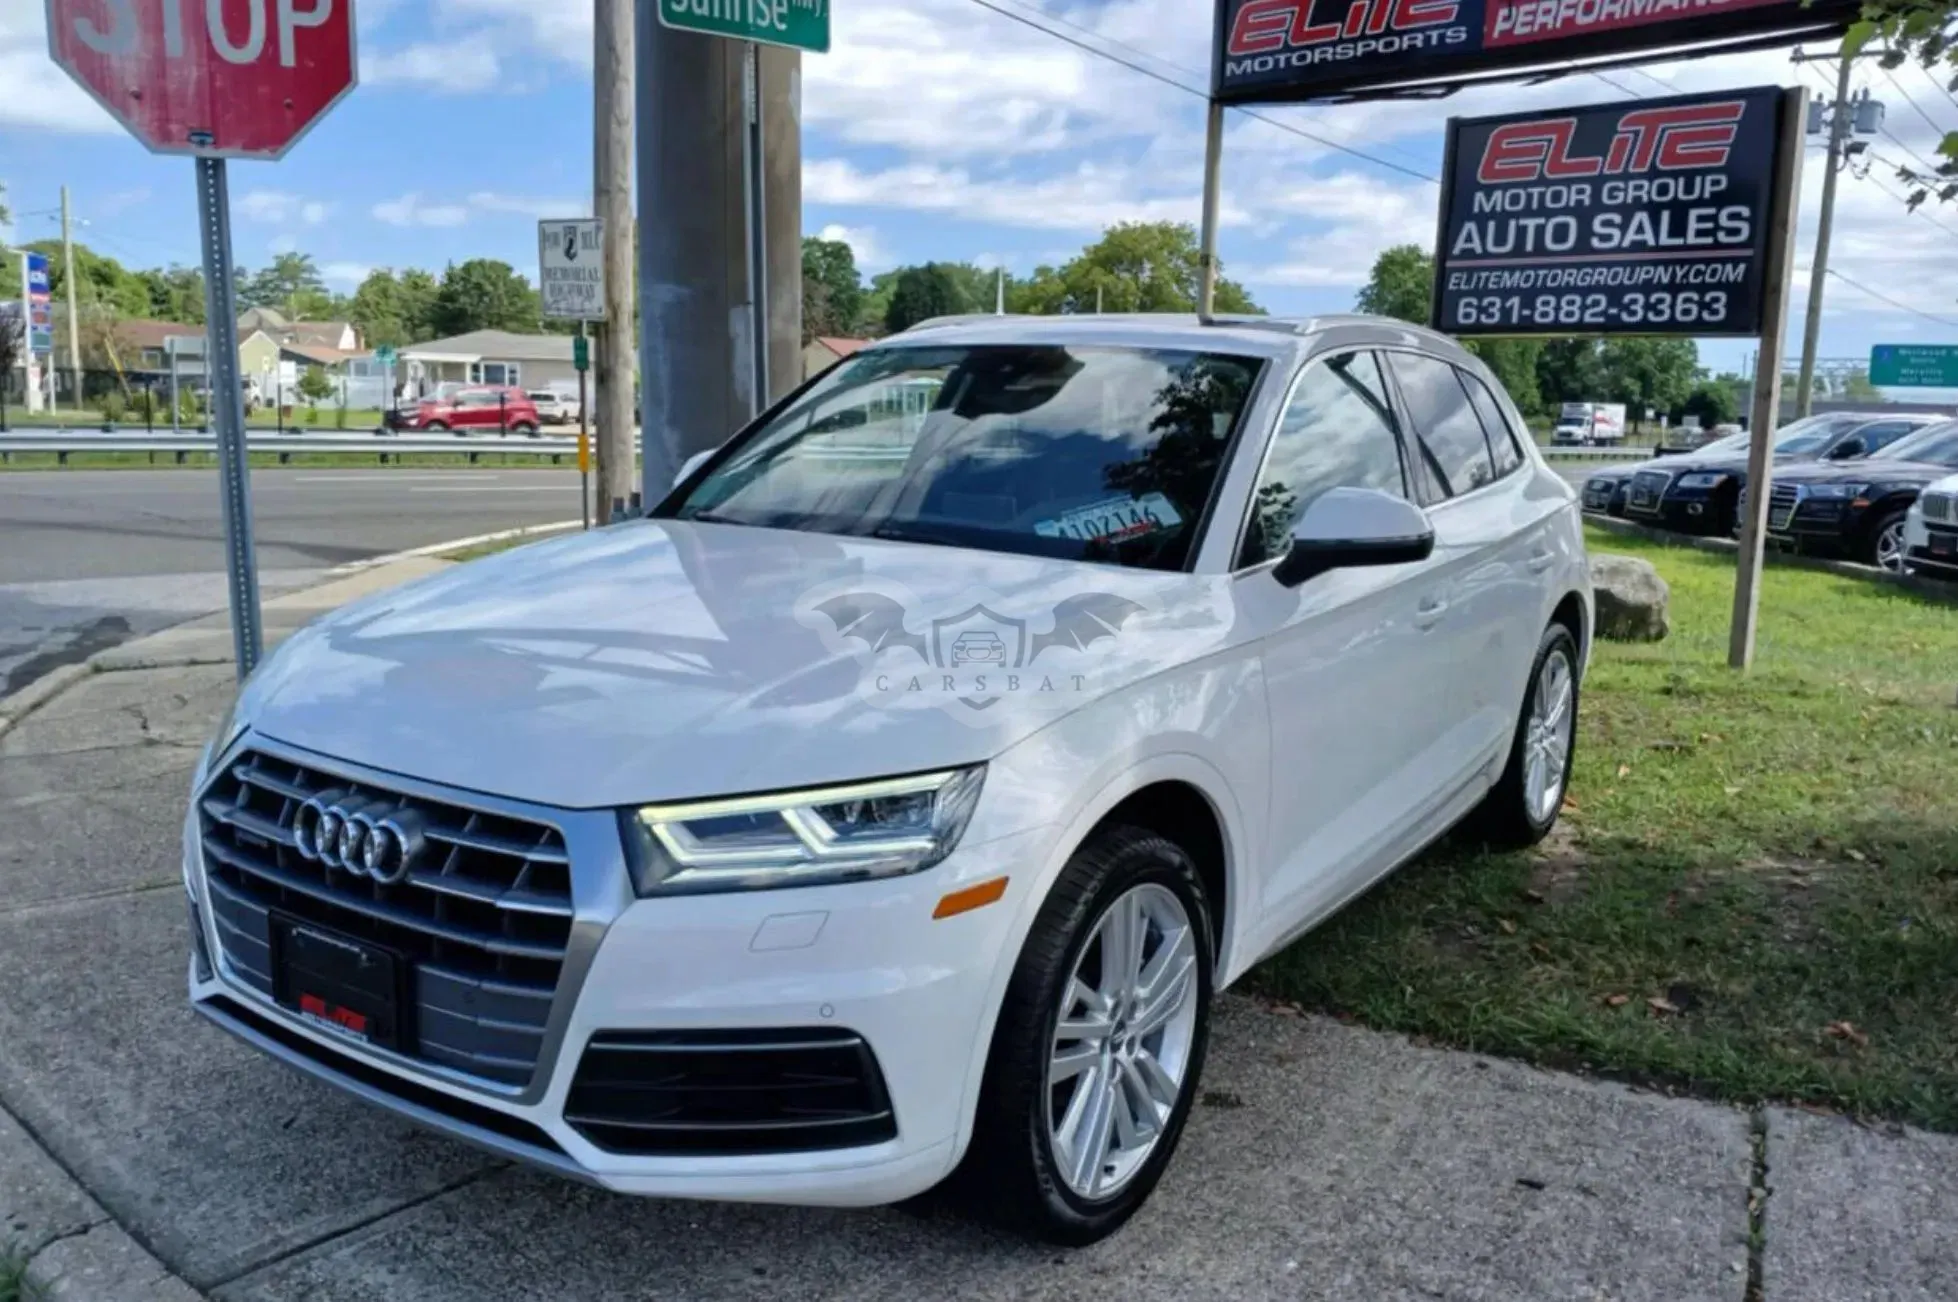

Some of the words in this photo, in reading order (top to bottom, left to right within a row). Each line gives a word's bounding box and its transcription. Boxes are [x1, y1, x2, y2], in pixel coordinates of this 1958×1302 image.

[74, 0, 333, 67] STOP
[1225, 26, 1468, 77] MOTORSPORTS
[1472, 183, 1592, 213] MOTOR
[1601, 174, 1728, 205] GROUP
[1452, 215, 1577, 255] AUTO
[1590, 205, 1750, 249] SALES
[1448, 263, 1747, 290] ELITEMOTORGROUPNY.COM
[1456, 291, 1728, 324] 631-882-3363
